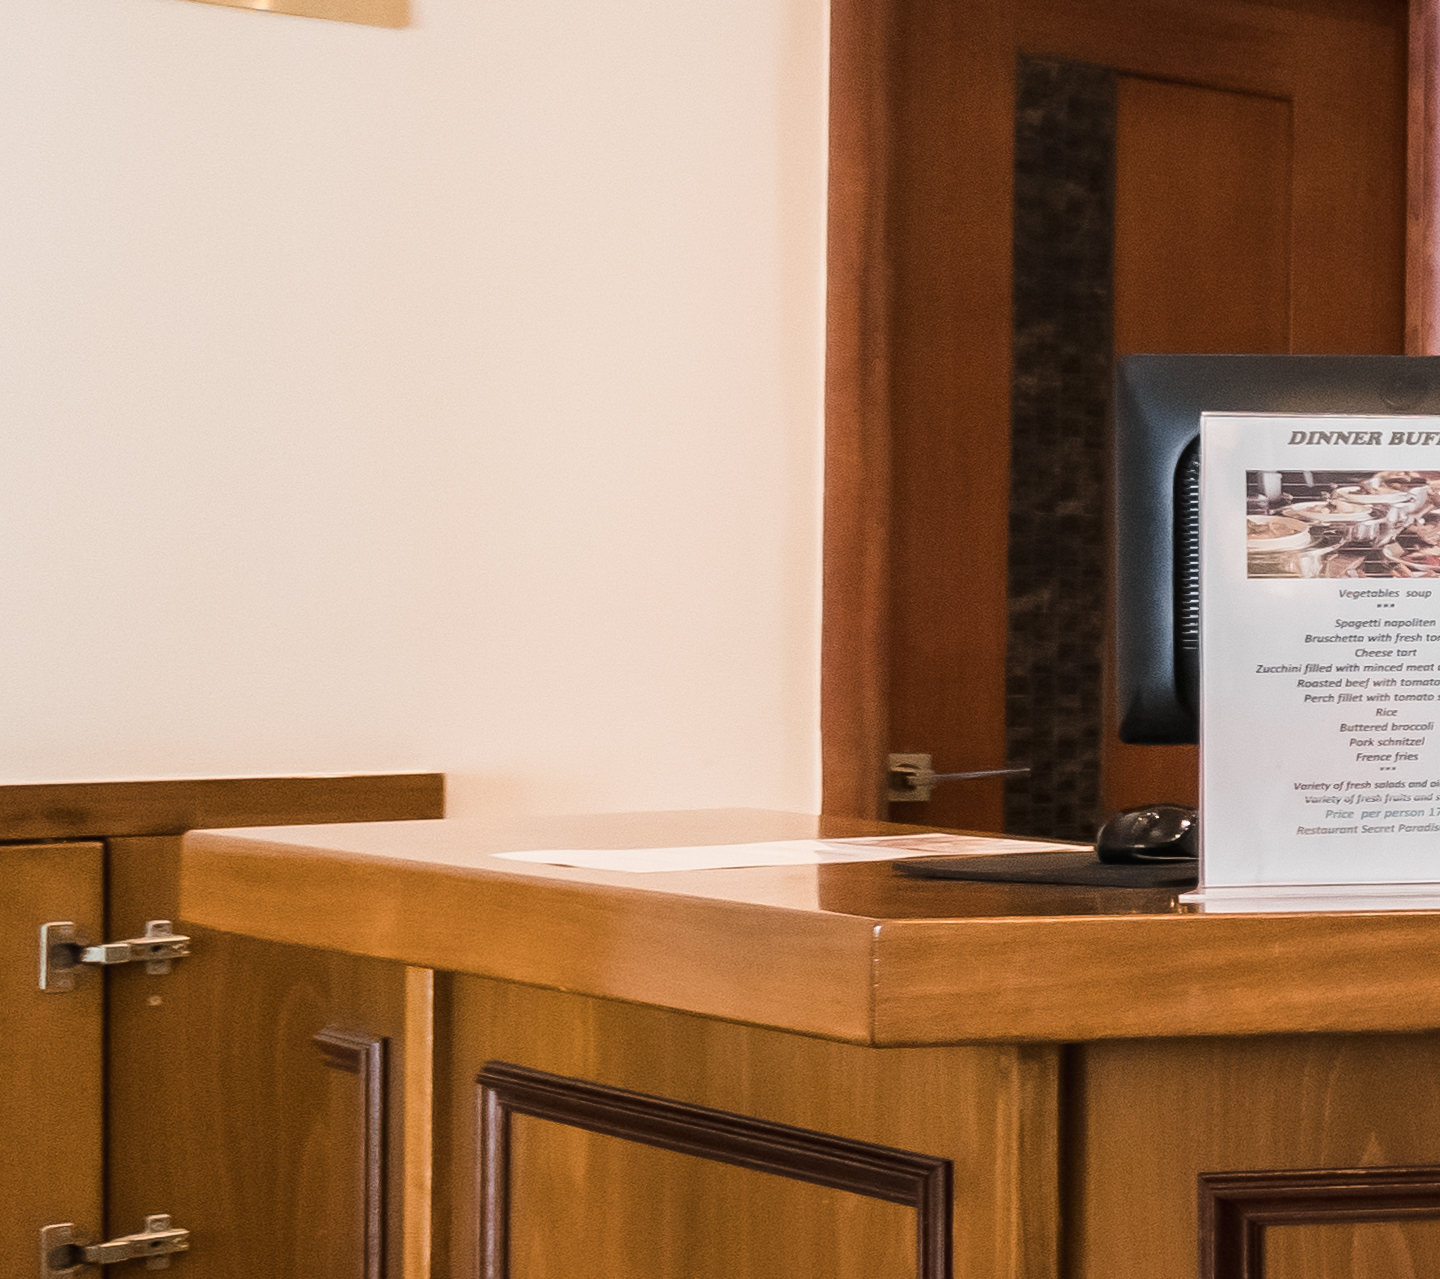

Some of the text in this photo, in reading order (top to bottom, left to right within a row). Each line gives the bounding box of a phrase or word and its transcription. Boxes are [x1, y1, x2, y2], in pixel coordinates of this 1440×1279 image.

[1288, 431, 1383, 446] DINNER
[1339, 589, 1432, 599] Vegetables soup
[1335, 619, 1381, 629] Spagetti
[1304, 635, 1364, 643] Bruschetta
[1368, 634, 1392, 642] with
[1395, 633, 1422, 644] fresh
[1355, 649, 1417, 657] Cheese tart
[1256, 664, 1301, 673] Zucchini
[1303, 663, 1333, 674] filled
[1336, 663, 1361, 672] with
[1364, 663, 1403, 672] minced
[1406, 663, 1434, 672] meat
[1297, 679, 1342, 688] Roasted
[1345, 678, 1371, 689] beef
[1373, 678, 1397, 687] with
[1401, 678, 1440, 687] tomato
[1304, 694, 1334, 703] Perch
[1337, 693, 1363, 705] fillet
[1366, 693, 1390, 701] with
[1376, 708, 1398, 717] Rice
[1340, 722, 1434, 732] Buttered broccoli
[1350, 737, 1425, 747] Pork schnitzel
[1394, 752, 1419, 763] fries
[1294, 782, 1331, 792] Variety
[1333, 781, 1344, 791] of
[1345, 781, 1371, 791] fresh
[1374, 780, 1405, 789] salads
[1408, 780, 1427, 788] and
[1305, 795, 1342, 805] Variety
[1344, 795, 1354, 804] of
[1356, 794, 1382, 804] fresh
[1326, 809, 1354, 819] Price
[1361, 810, 1381, 819] per
[1384, 809, 1425, 819] person
[1297, 825, 1358, 835] Restaurant
[1361, 824, 1395, 833] Secret
